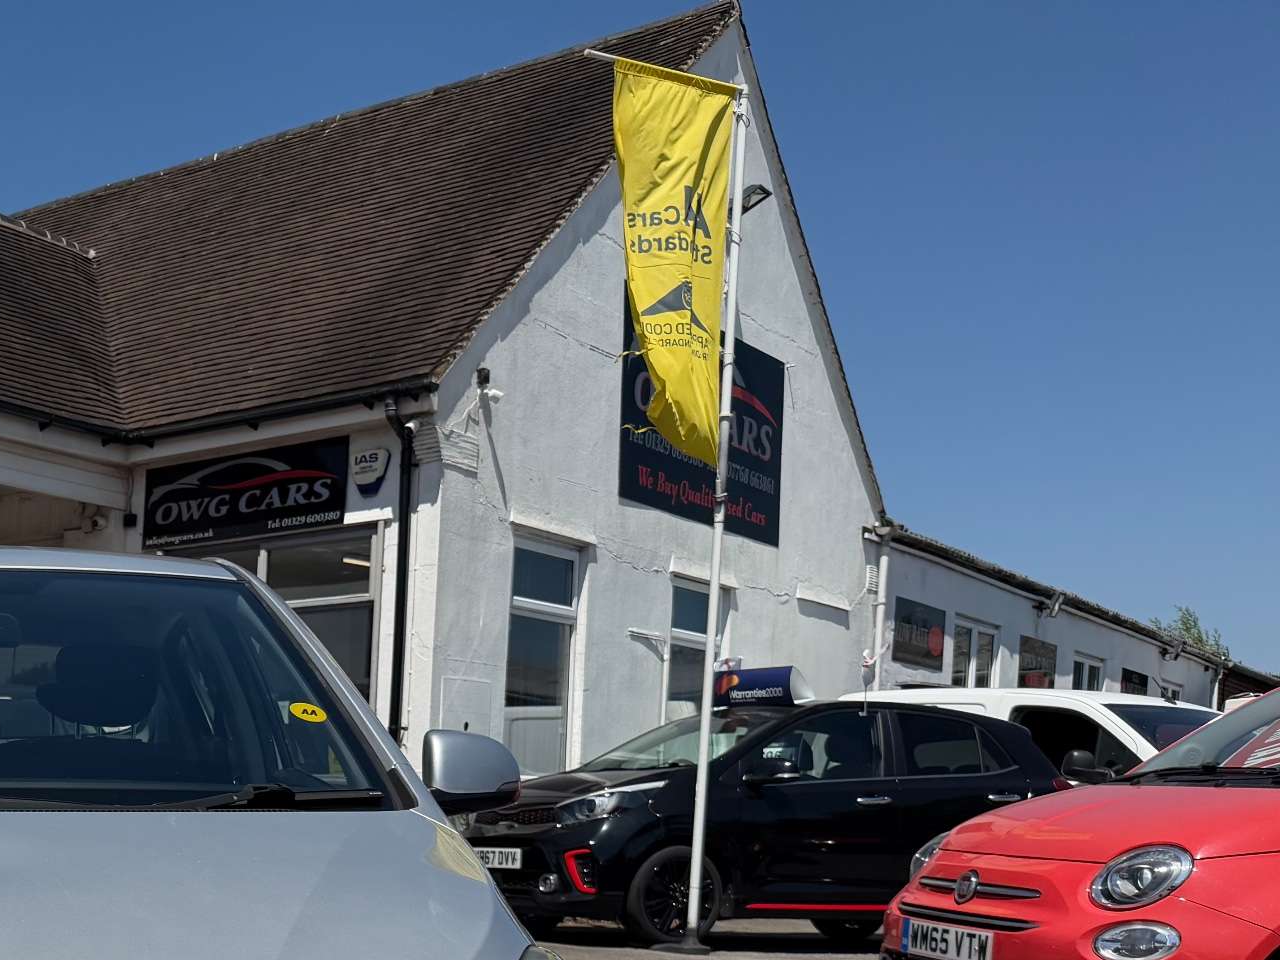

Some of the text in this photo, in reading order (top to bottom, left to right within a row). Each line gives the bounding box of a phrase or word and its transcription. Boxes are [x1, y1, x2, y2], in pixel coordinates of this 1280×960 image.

[354, 452, 379, 466] IAS
[155, 478, 332, 525] OWG CARS
[639, 464, 654, 489] We
[657, 471, 679, 506] Buy
[725, 495, 743, 518] sed
[744, 503, 767, 526] Cars
[282, 514, 306, 528] 01329
[728, 687, 783, 700] Warranties2000
[302, 708, 318, 717] AA
[911, 922, 950, 955] WM65
